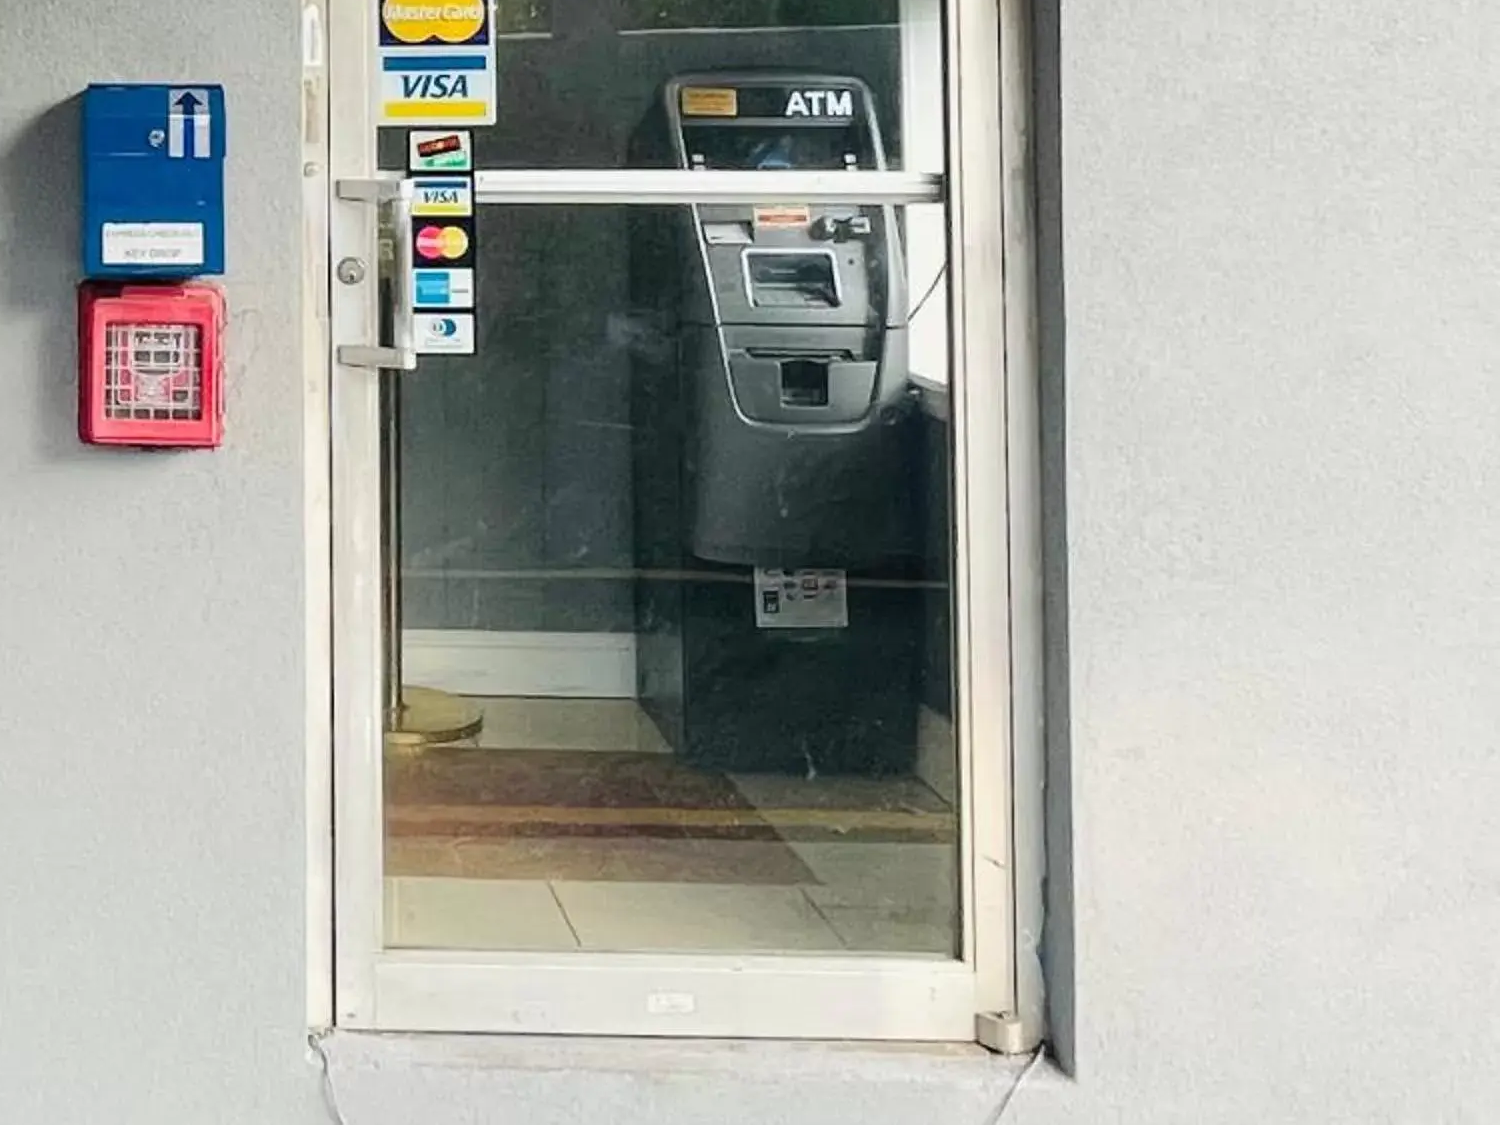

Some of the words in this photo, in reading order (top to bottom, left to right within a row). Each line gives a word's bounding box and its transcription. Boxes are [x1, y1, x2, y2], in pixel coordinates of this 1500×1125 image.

[386, 4, 482, 22] MasterCard
[401, 74, 469, 99] VISA
[785, 90, 853, 117] ATM
[423, 190, 459, 204] VISA
